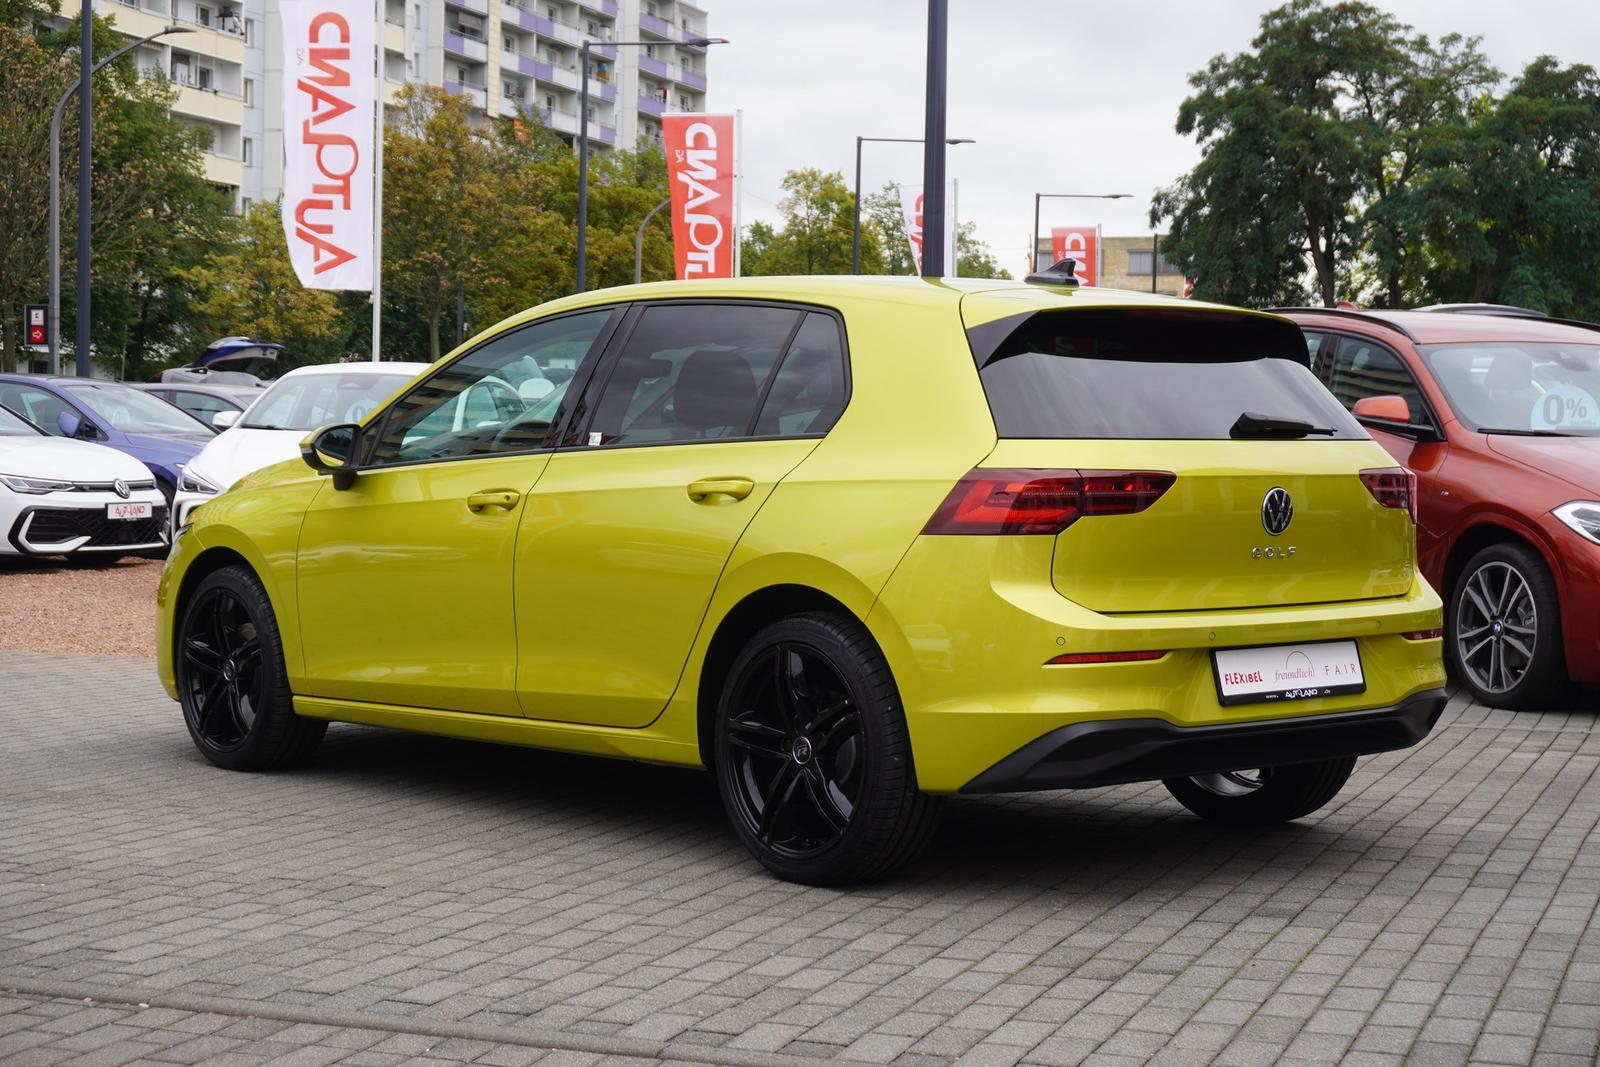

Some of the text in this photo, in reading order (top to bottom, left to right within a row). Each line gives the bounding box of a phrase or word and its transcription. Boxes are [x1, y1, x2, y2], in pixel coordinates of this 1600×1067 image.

[1543, 394, 1587, 425] 0%
[1252, 546, 1297, 558] GOLF
[1275, 667, 1314, 683] freundlich
[1285, 688, 1318, 698] AUTOLAND
